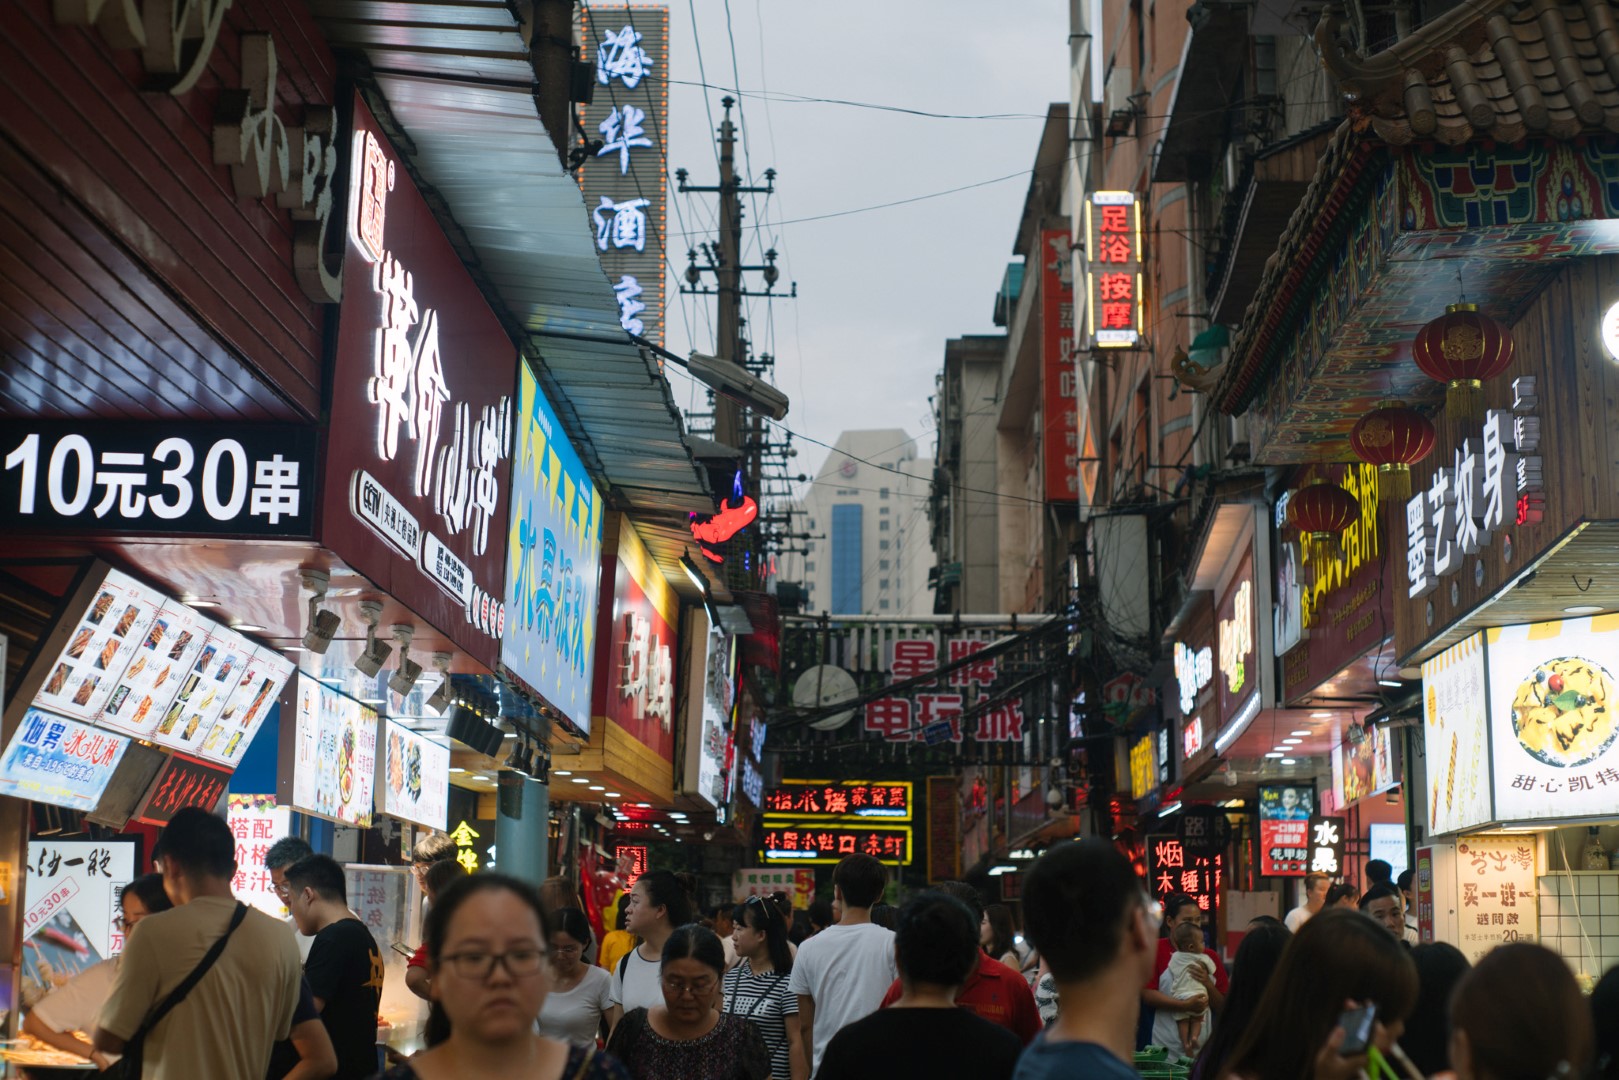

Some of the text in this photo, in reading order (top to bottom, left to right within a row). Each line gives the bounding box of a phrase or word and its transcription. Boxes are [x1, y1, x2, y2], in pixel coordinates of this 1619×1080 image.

[1100, 205, 1133, 329] 足浴按摩
[1512, 376, 1533, 492] 工作室
[5, 434, 300, 524] 10元30串
[364, 480, 382, 518] CCTV
[1406, 409, 1506, 599] 墨艺纹身
[865, 693, 1023, 742] 电玩城
[229, 817, 274, 839] 搭配
[1311, 820, 1339, 874] 水果
[1270, 848, 1308, 862] 花甲粉
[794, 869, 816, 894] 5
[1463, 882, 1535, 907] 买一送一
[1476, 912, 1519, 926] 送同款
